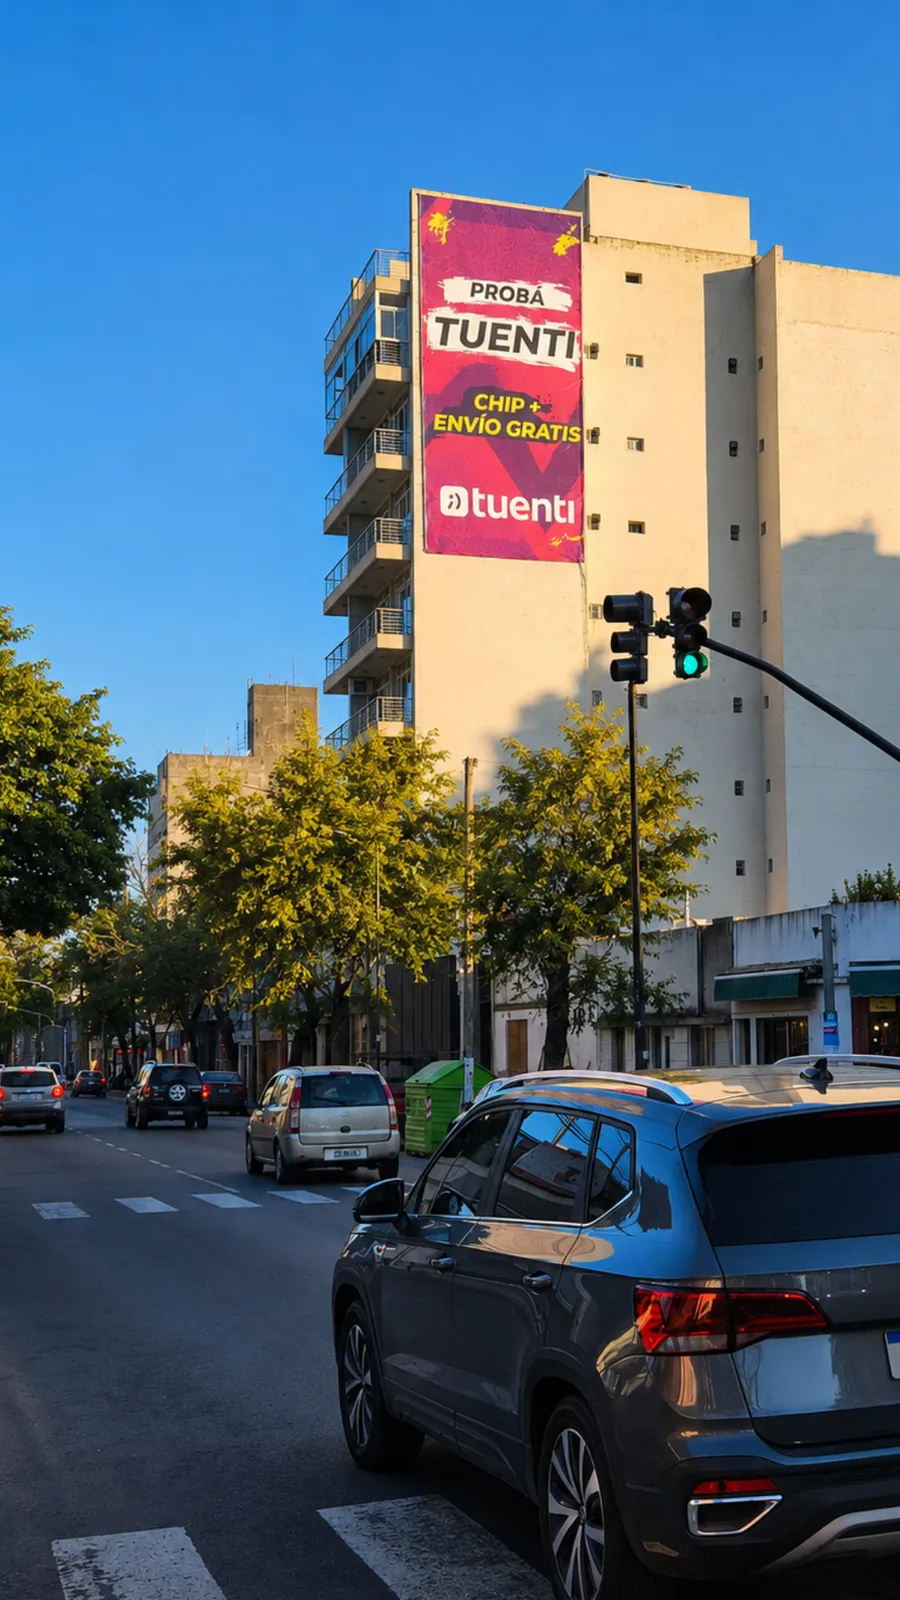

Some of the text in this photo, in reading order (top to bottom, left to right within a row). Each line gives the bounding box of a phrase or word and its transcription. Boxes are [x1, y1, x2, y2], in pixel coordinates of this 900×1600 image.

[470, 282, 544, 306] PROBÁ
[435, 316, 576, 359] TUENTI
[474, 393, 541, 413] CHIP +
[433, 413, 582, 443] ENVÍO GRATIS
[471, 487, 575, 524] tuenti
